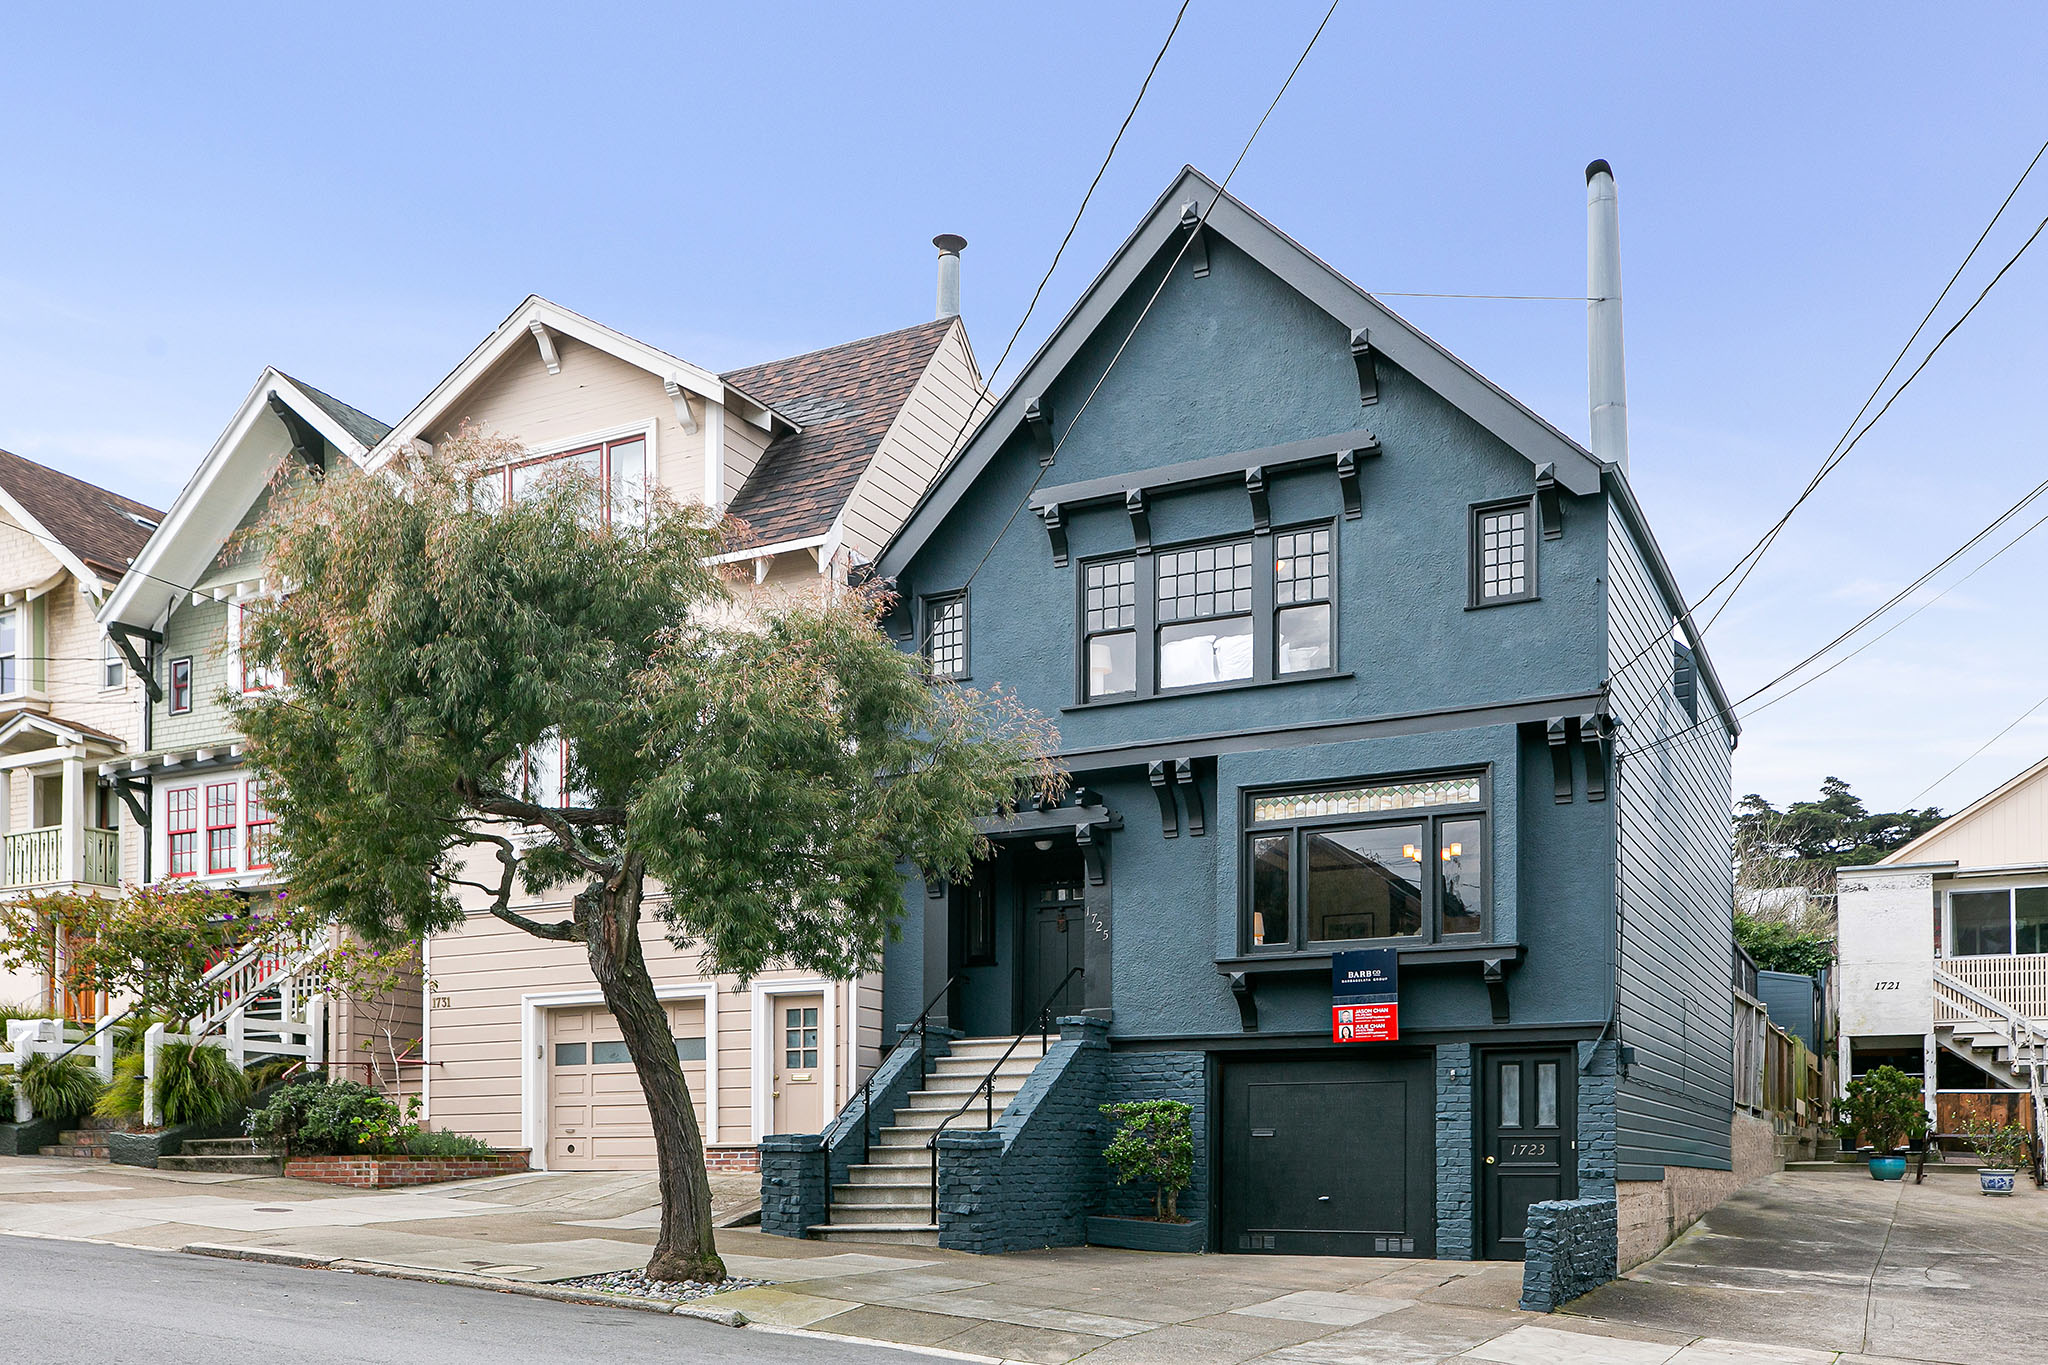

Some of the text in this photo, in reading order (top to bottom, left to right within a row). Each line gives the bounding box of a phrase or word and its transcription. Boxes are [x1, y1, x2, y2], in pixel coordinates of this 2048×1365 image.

[1086, 906, 1109, 940] 1725
[1348, 970, 1372, 978] BARB
[1874, 981, 1900, 991] 1721
[432, 996, 451, 1008] 1731
[1511, 1143, 1545, 1156] 1723
